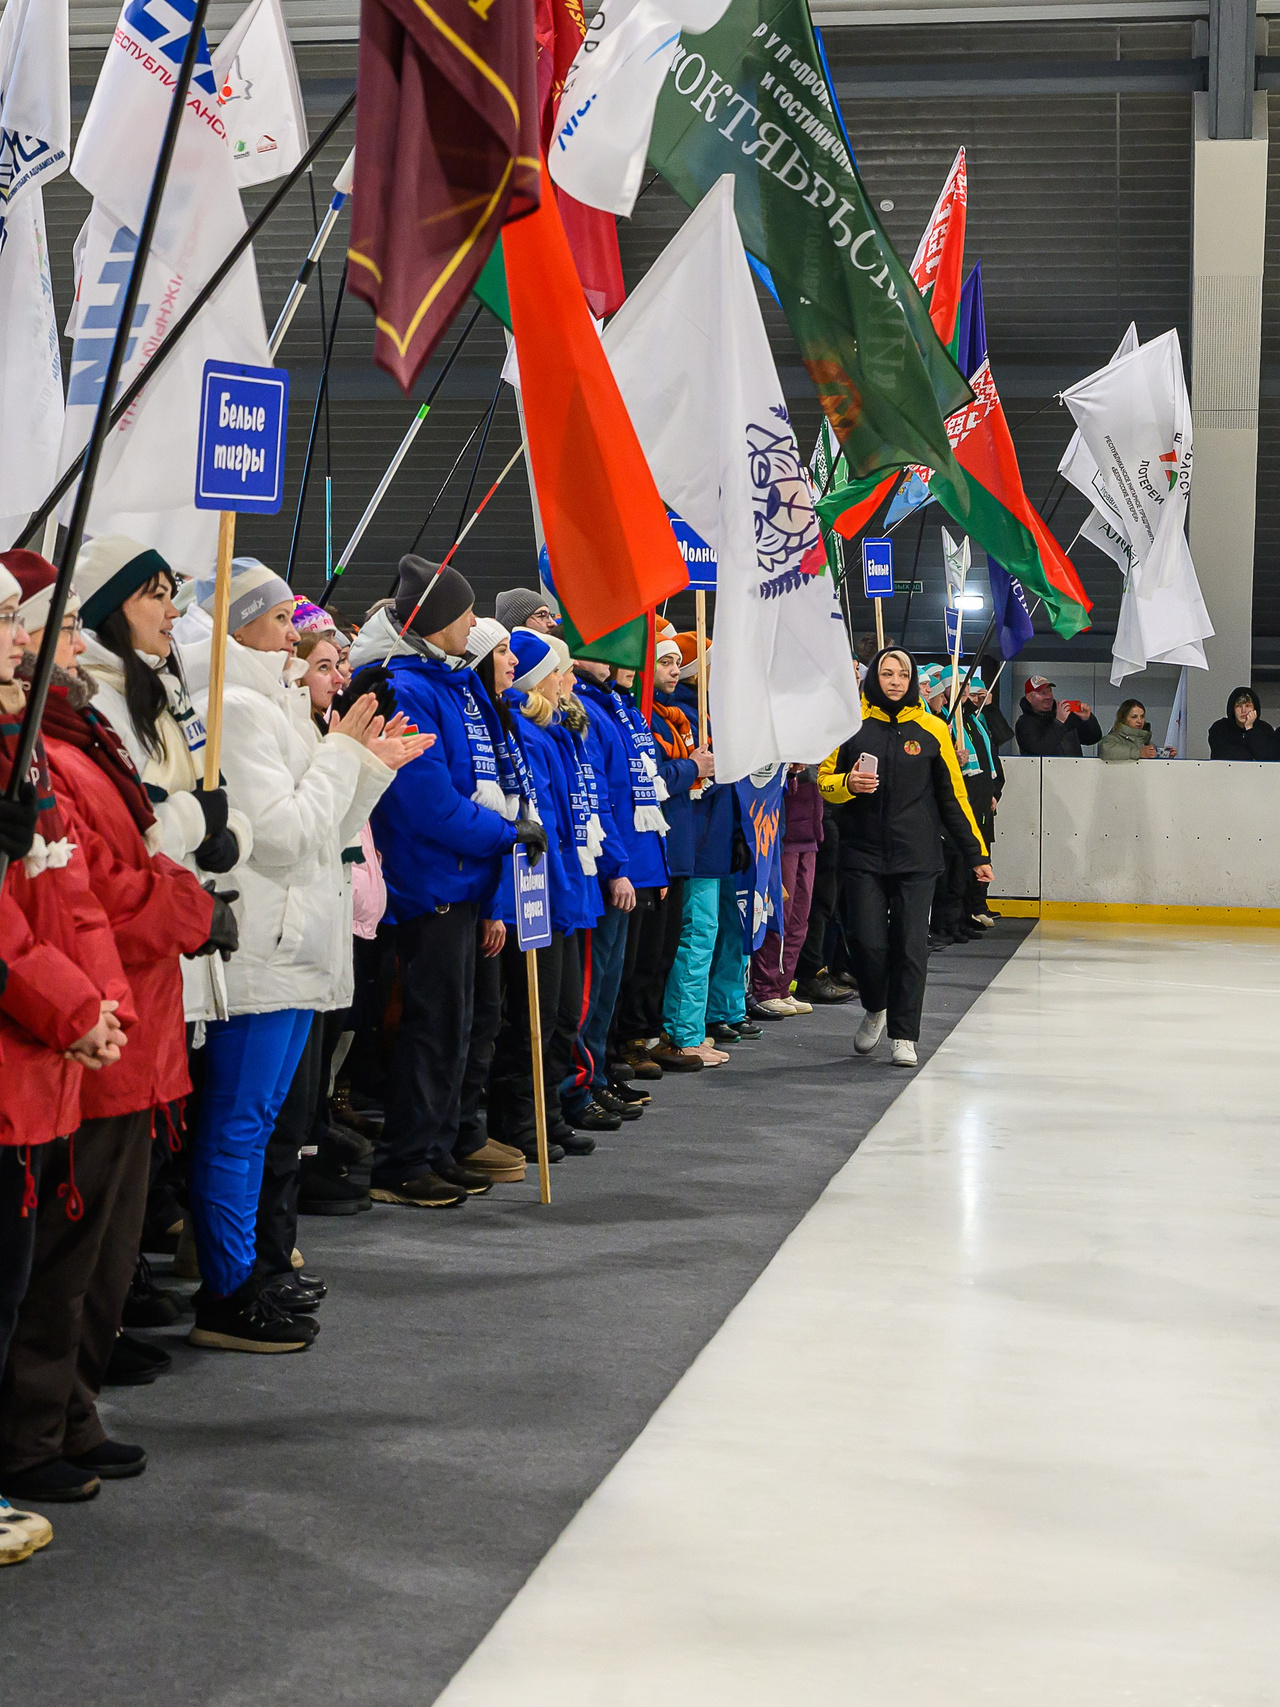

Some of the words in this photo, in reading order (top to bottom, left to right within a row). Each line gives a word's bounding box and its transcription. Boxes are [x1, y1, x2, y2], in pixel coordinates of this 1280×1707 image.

[760, 71, 776, 91] И
[219, 391, 266, 432] Белые
[214, 444, 265, 483] тигры
[1138, 460, 1165, 505] ЛОТЕРЕИ
[868, 558, 889, 577] Единые
